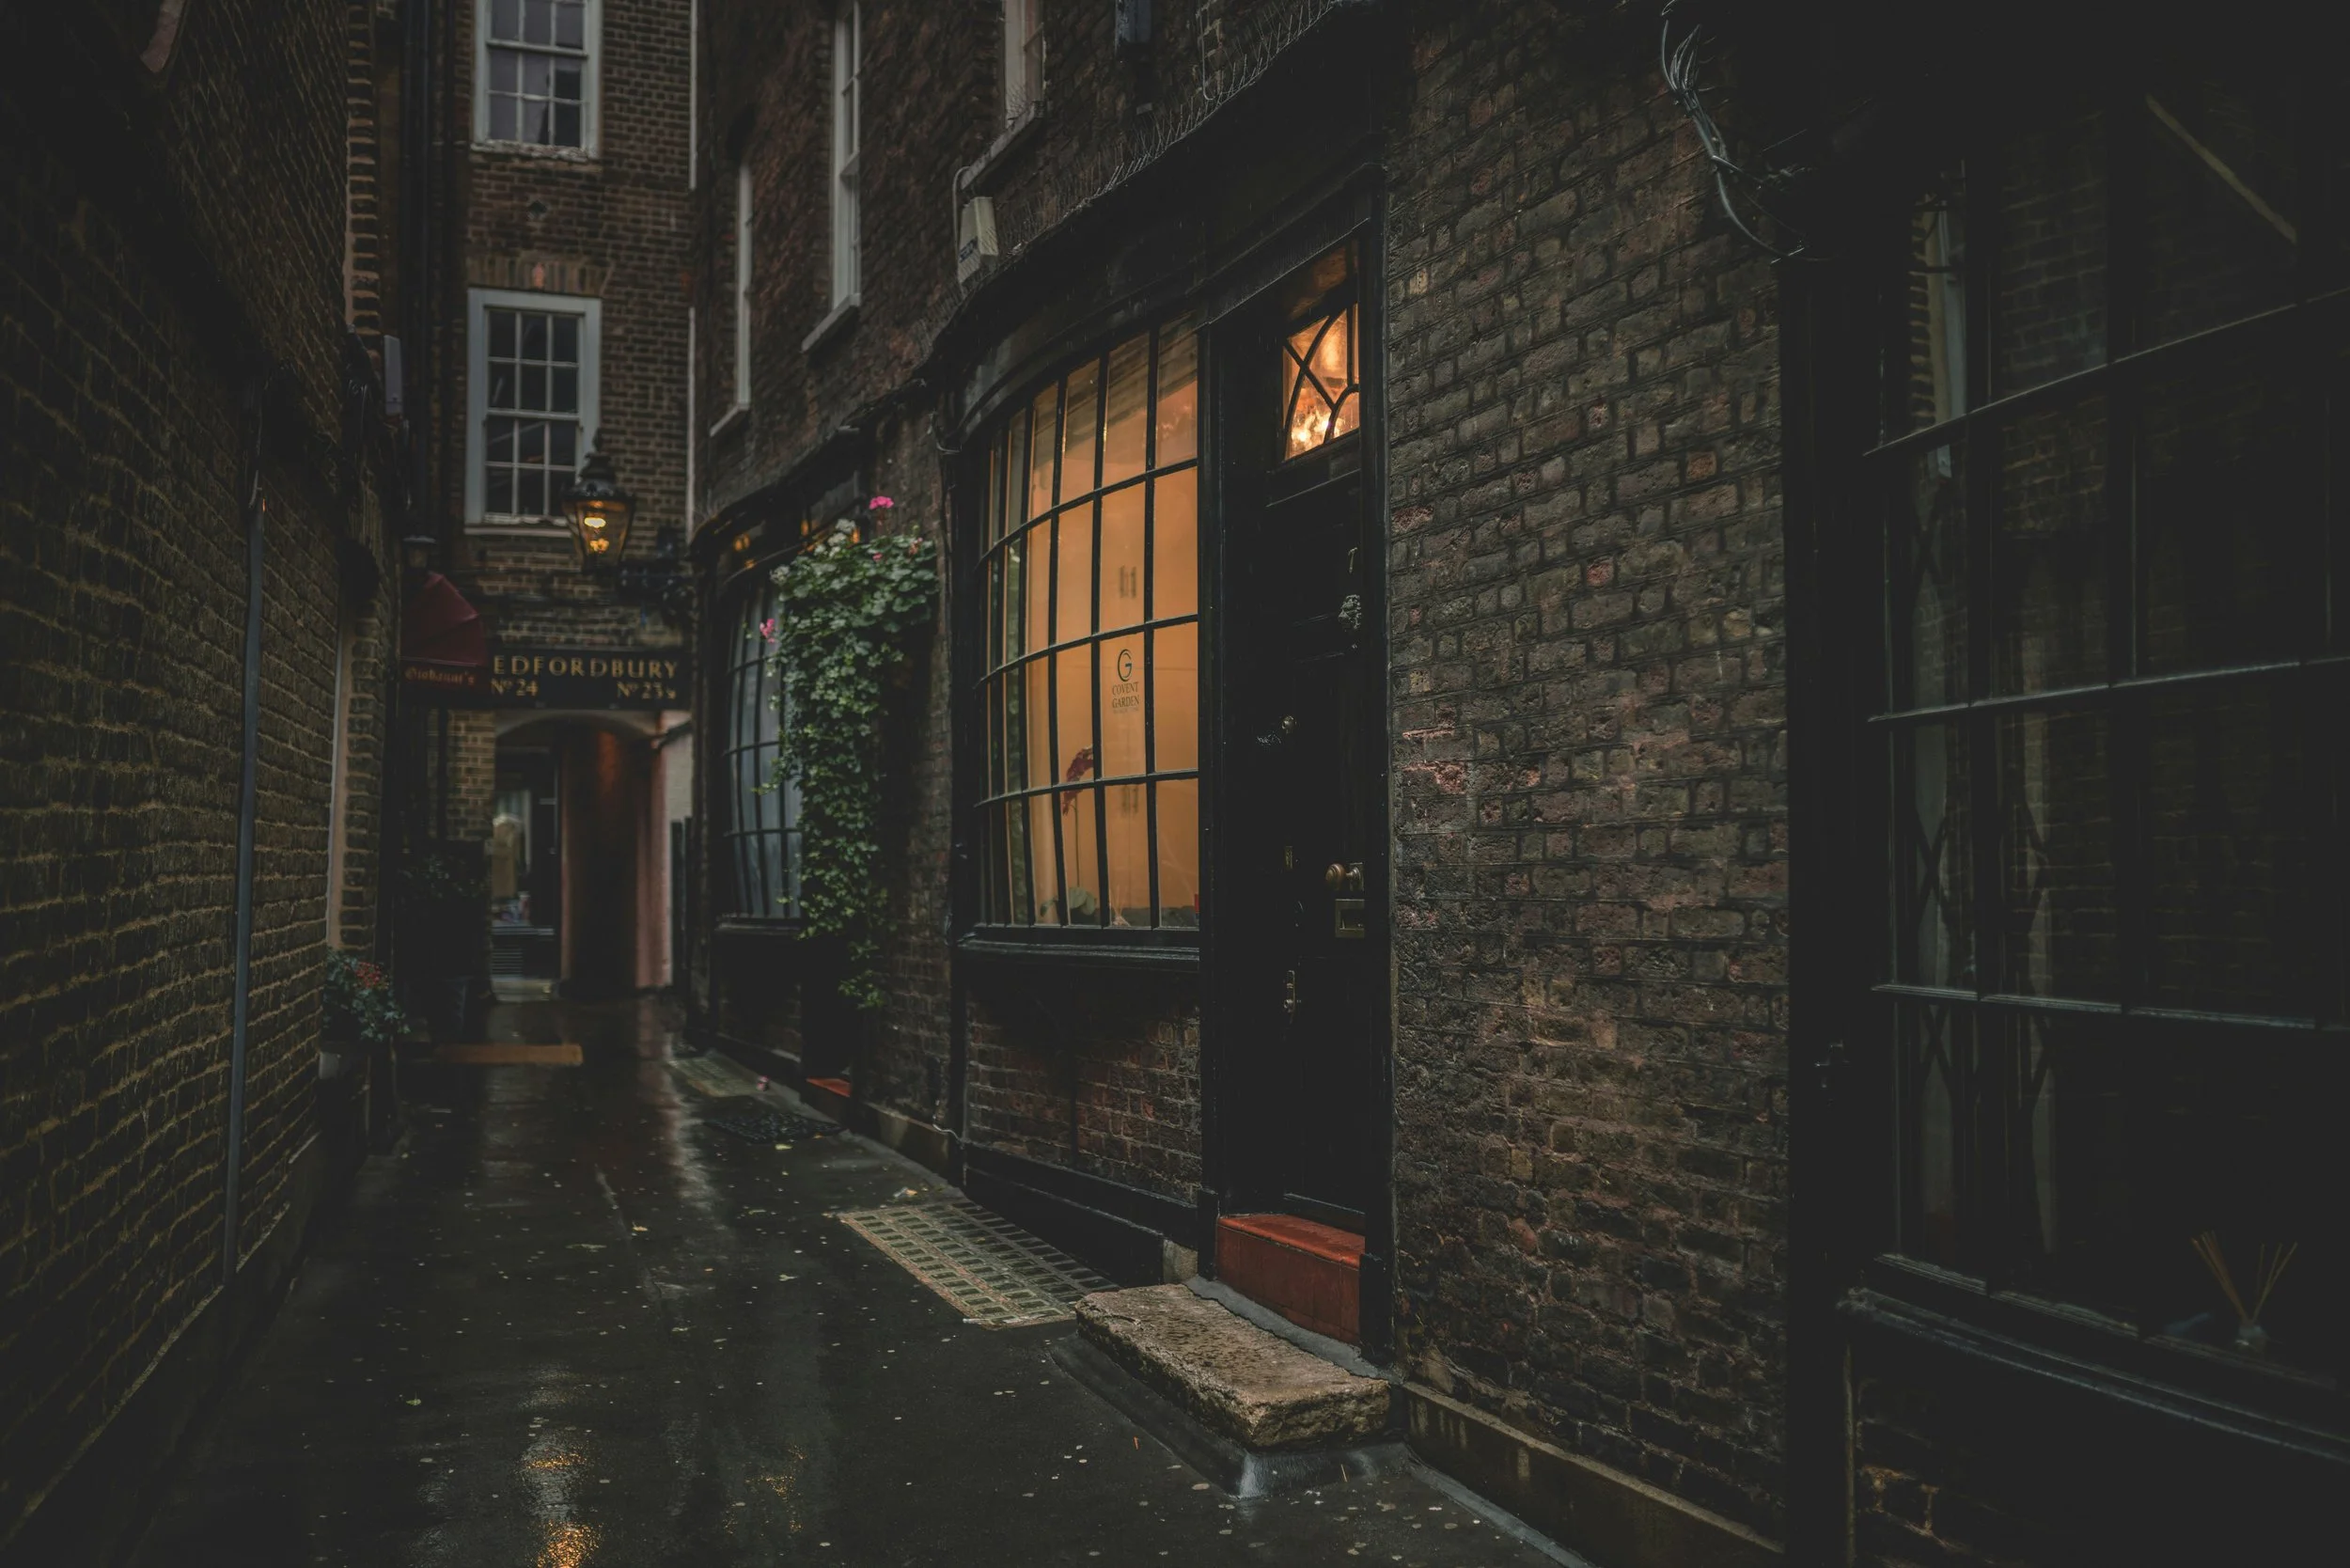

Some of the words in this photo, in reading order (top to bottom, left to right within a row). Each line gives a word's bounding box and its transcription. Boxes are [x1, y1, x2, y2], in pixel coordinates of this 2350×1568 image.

[494, 654, 678, 680] EDFORDBURY
[515, 678, 540, 697] 24
[1112, 682, 1139, 696] COVENT
[1112, 696, 1140, 709] GARDEN
